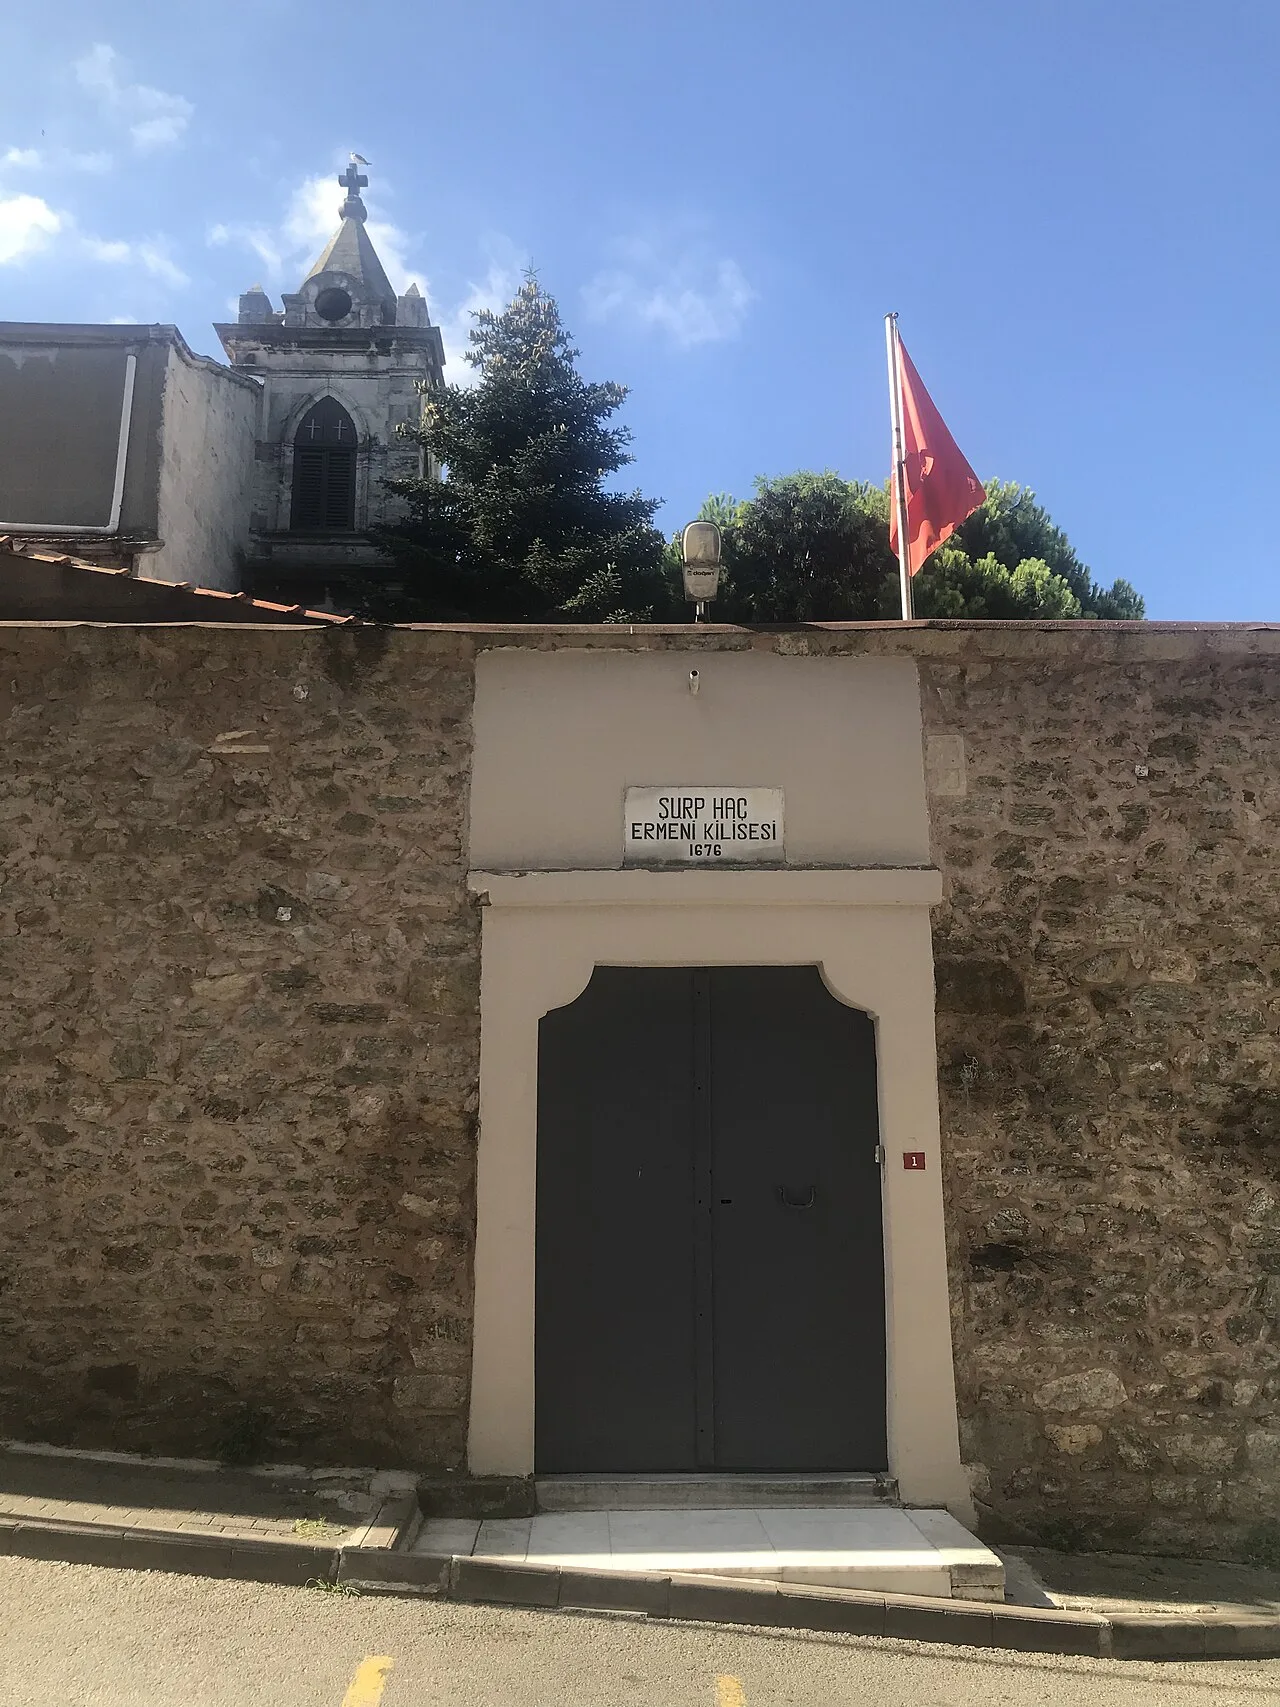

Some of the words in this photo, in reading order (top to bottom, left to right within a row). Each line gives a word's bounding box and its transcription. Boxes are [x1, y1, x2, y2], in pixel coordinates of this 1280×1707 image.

[713, 797, 748, 821] HAÇ
[631, 820, 696, 840] ERMENİ
[704, 820, 776, 840] KİLİSESİ
[689, 844, 722, 857] 1676
[911, 1156, 918, 1167] 1
